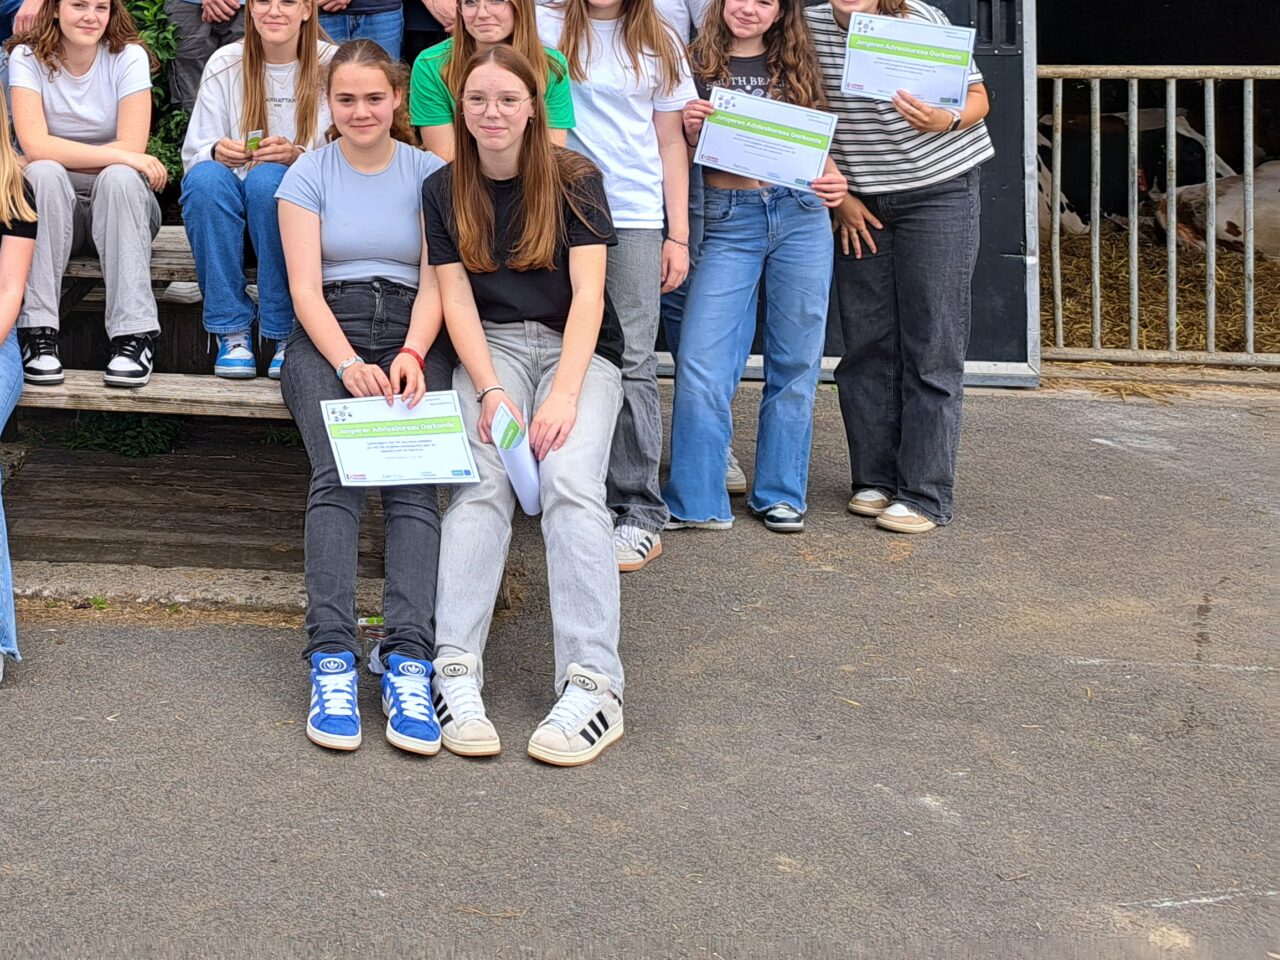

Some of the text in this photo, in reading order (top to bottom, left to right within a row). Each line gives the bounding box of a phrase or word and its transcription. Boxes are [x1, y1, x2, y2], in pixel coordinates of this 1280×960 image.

[885, 43, 929, 56] Adviesbureau
[706, 76, 746, 91] SUTH
[371, 423, 419, 434] Adviesbureau
[420, 420, 455, 431] Oorkonde
